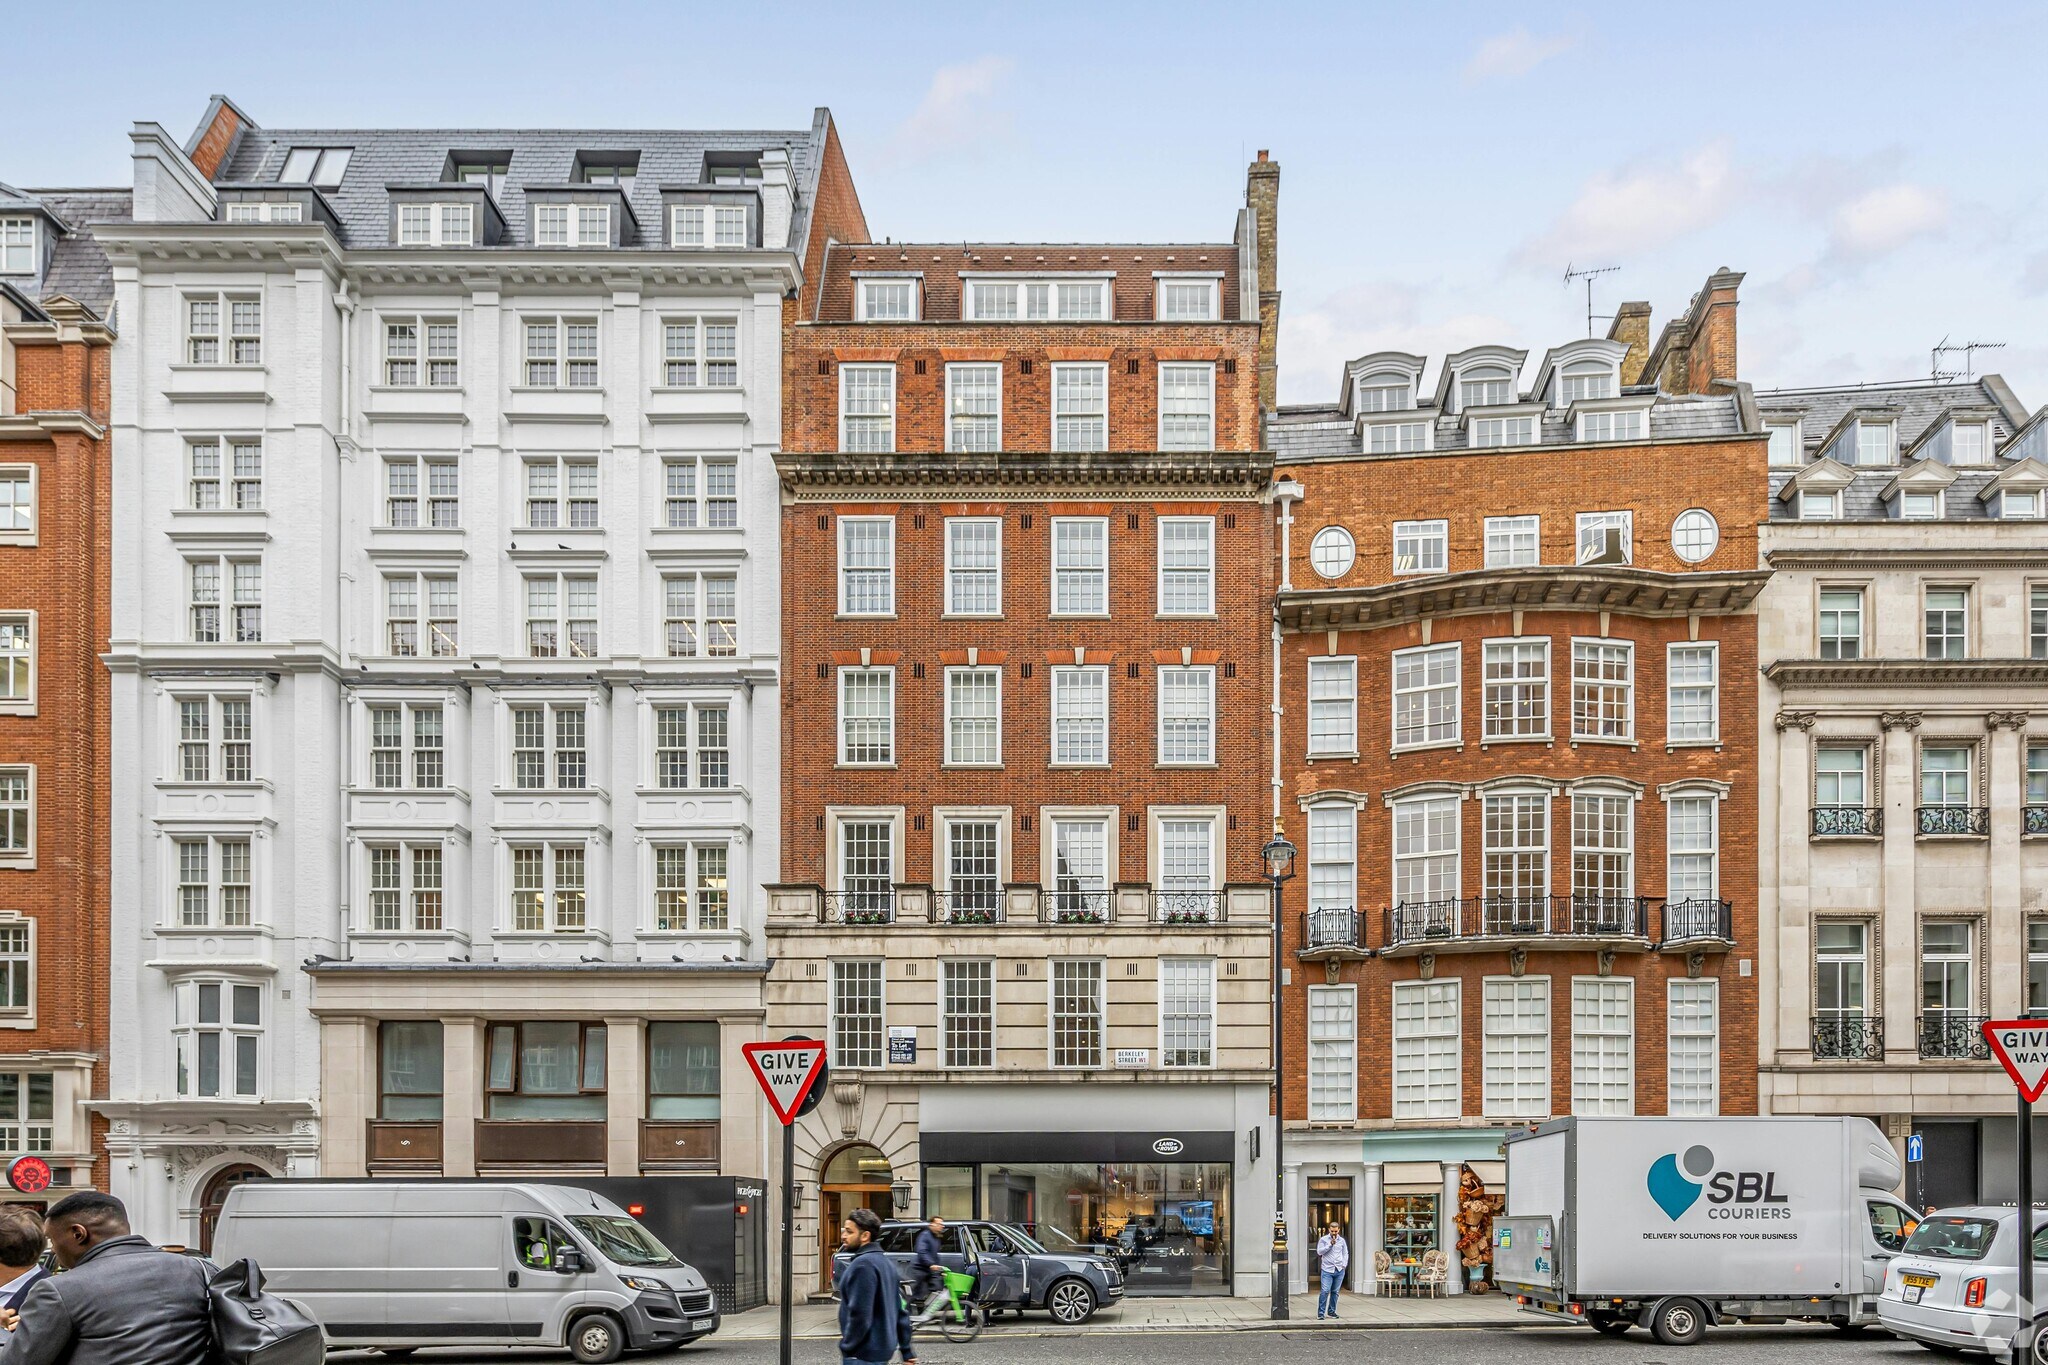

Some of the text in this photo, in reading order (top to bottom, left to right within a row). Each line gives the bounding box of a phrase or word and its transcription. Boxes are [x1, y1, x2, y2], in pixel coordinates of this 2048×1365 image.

[2003, 1031, 2048, 1049] GIV
[761, 1053, 808, 1070] GIVE
[2015, 1053, 2048, 1063] WAY
[772, 1074, 801, 1085] WAY
[1326, 1164, 1337, 1175] 13
[1706, 1171, 1788, 1204] SBL
[1708, 1207, 1791, 1220] COURIERS
[795, 1223, 802, 1231] 4
[1642, 1232, 1798, 1240] DELIVERY SOLUTIONS FOR YOUR BUSINESS
